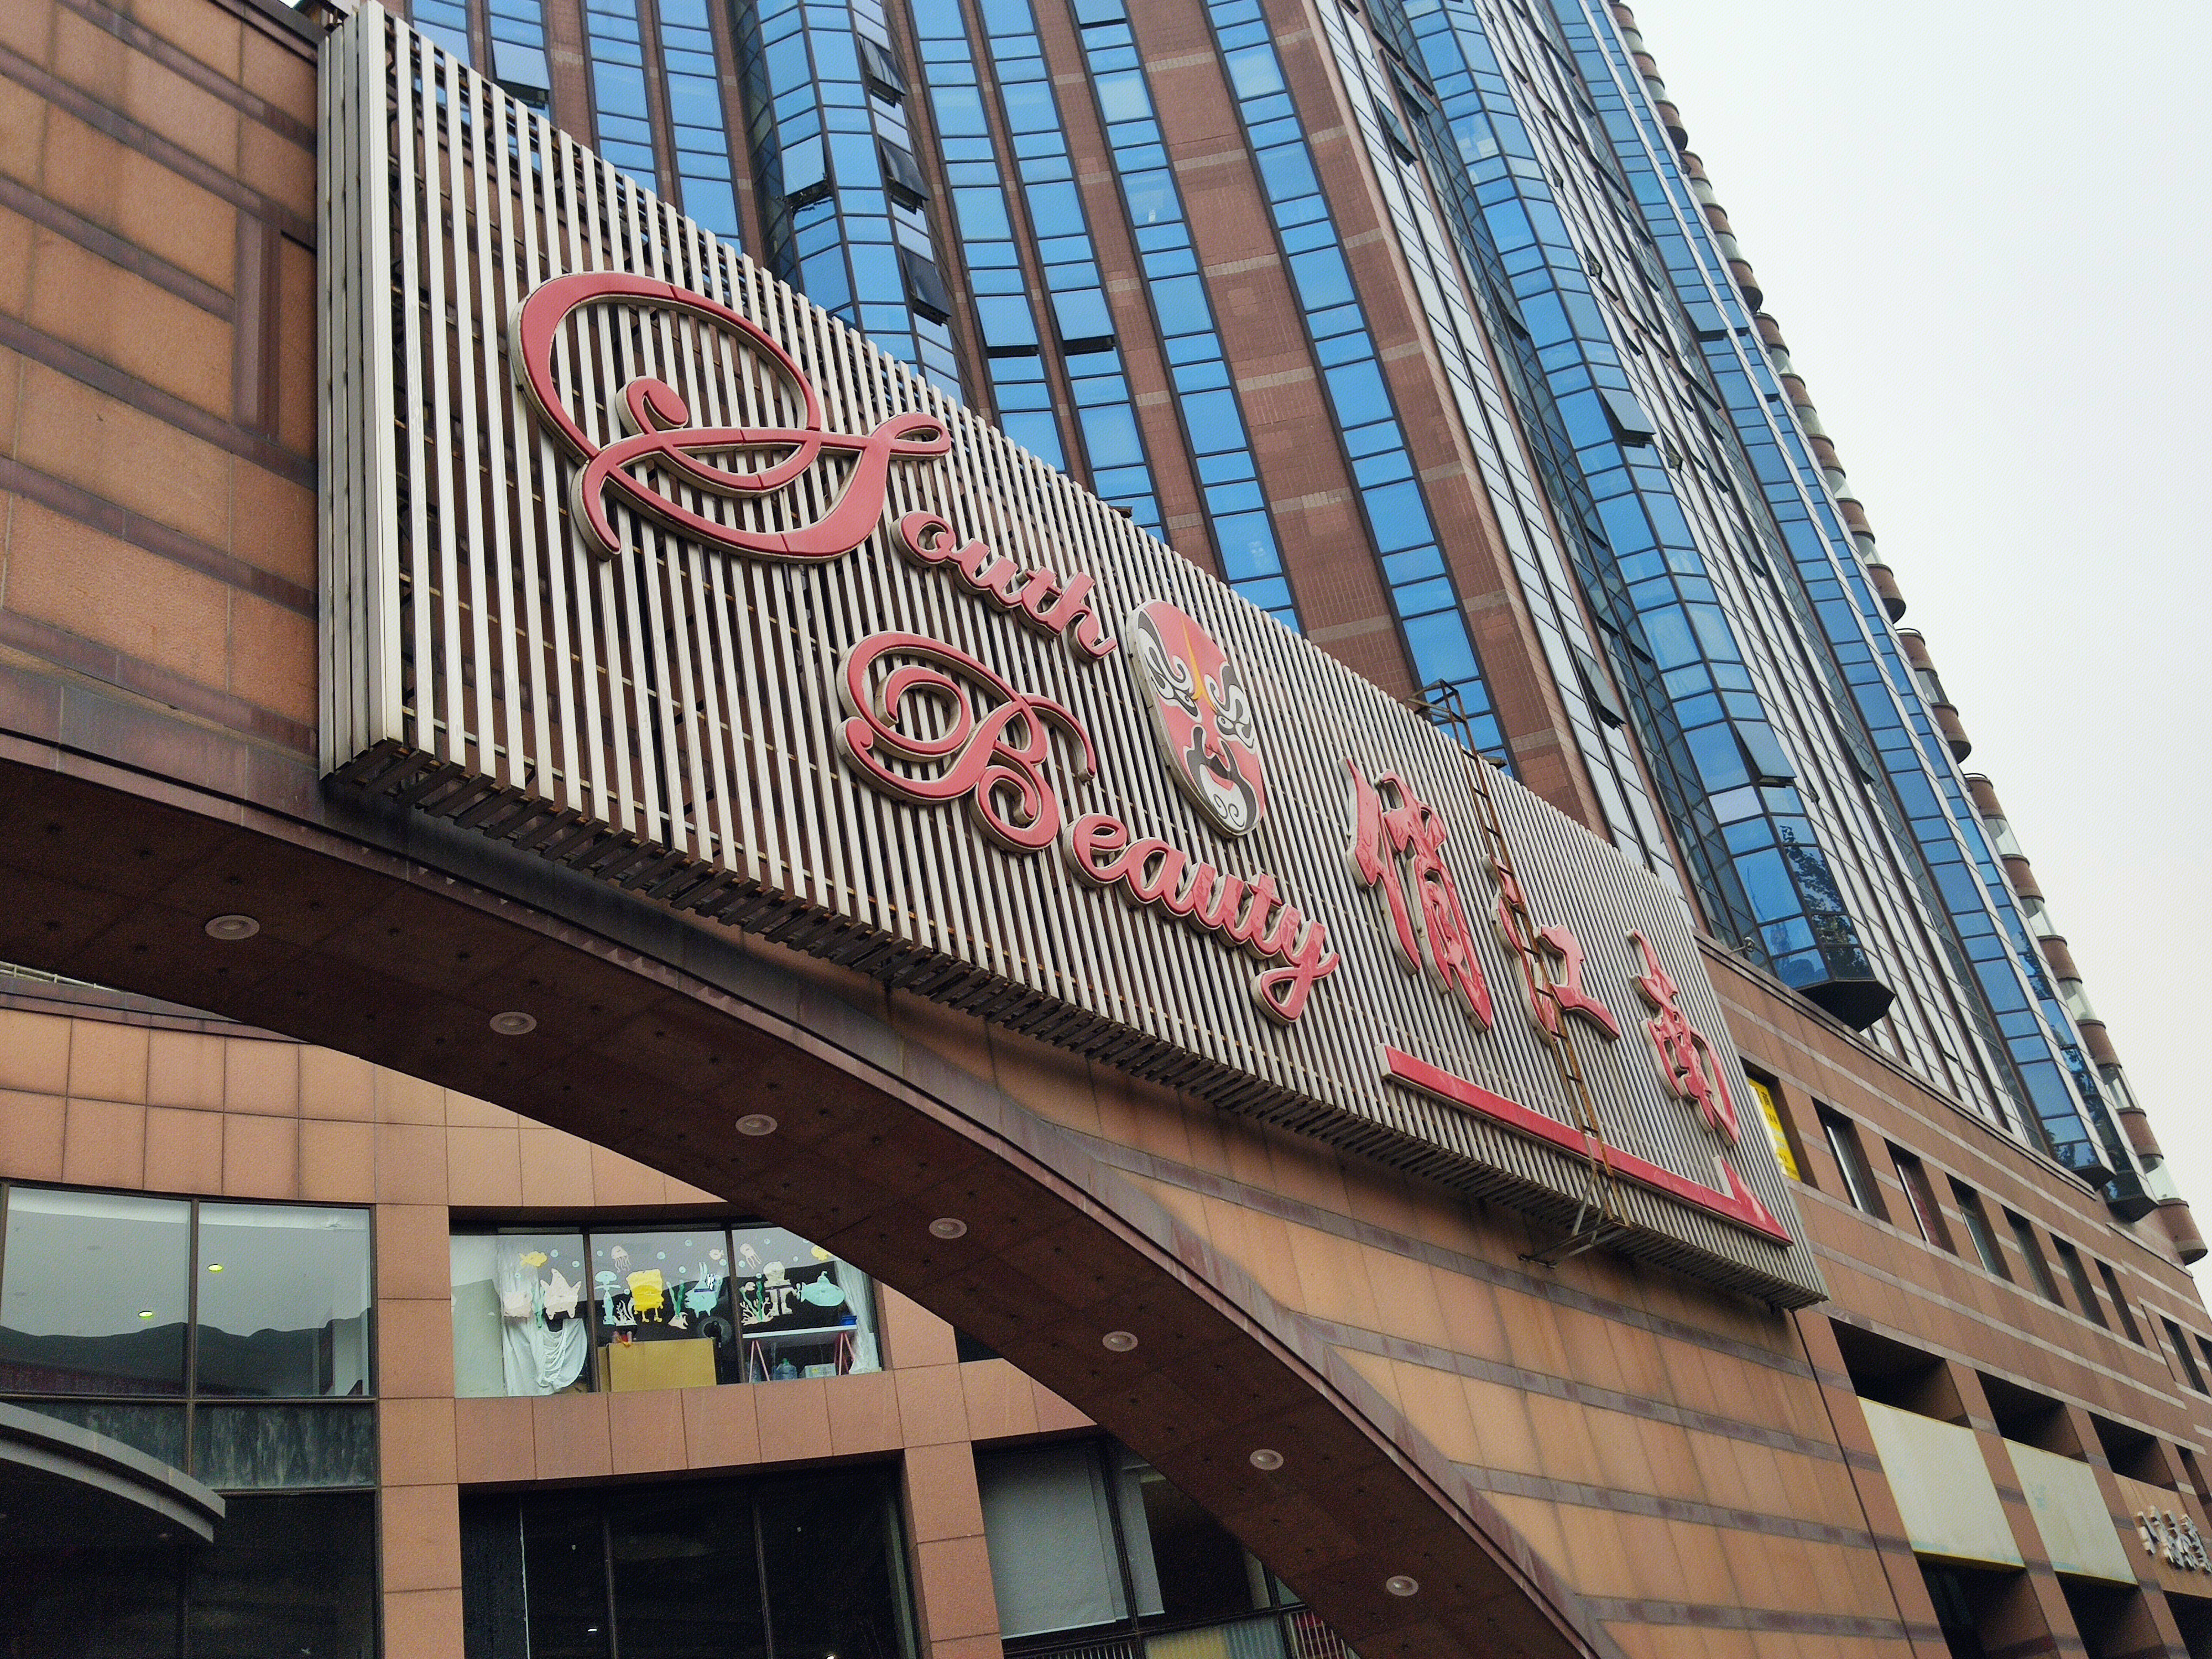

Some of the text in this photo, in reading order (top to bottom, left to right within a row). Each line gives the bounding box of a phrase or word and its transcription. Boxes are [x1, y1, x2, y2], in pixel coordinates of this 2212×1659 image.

[511, 270, 1117, 660] South
[835, 630, 1340, 1025] Beauty
[1339, 757, 1739, 1146] 俏江南
